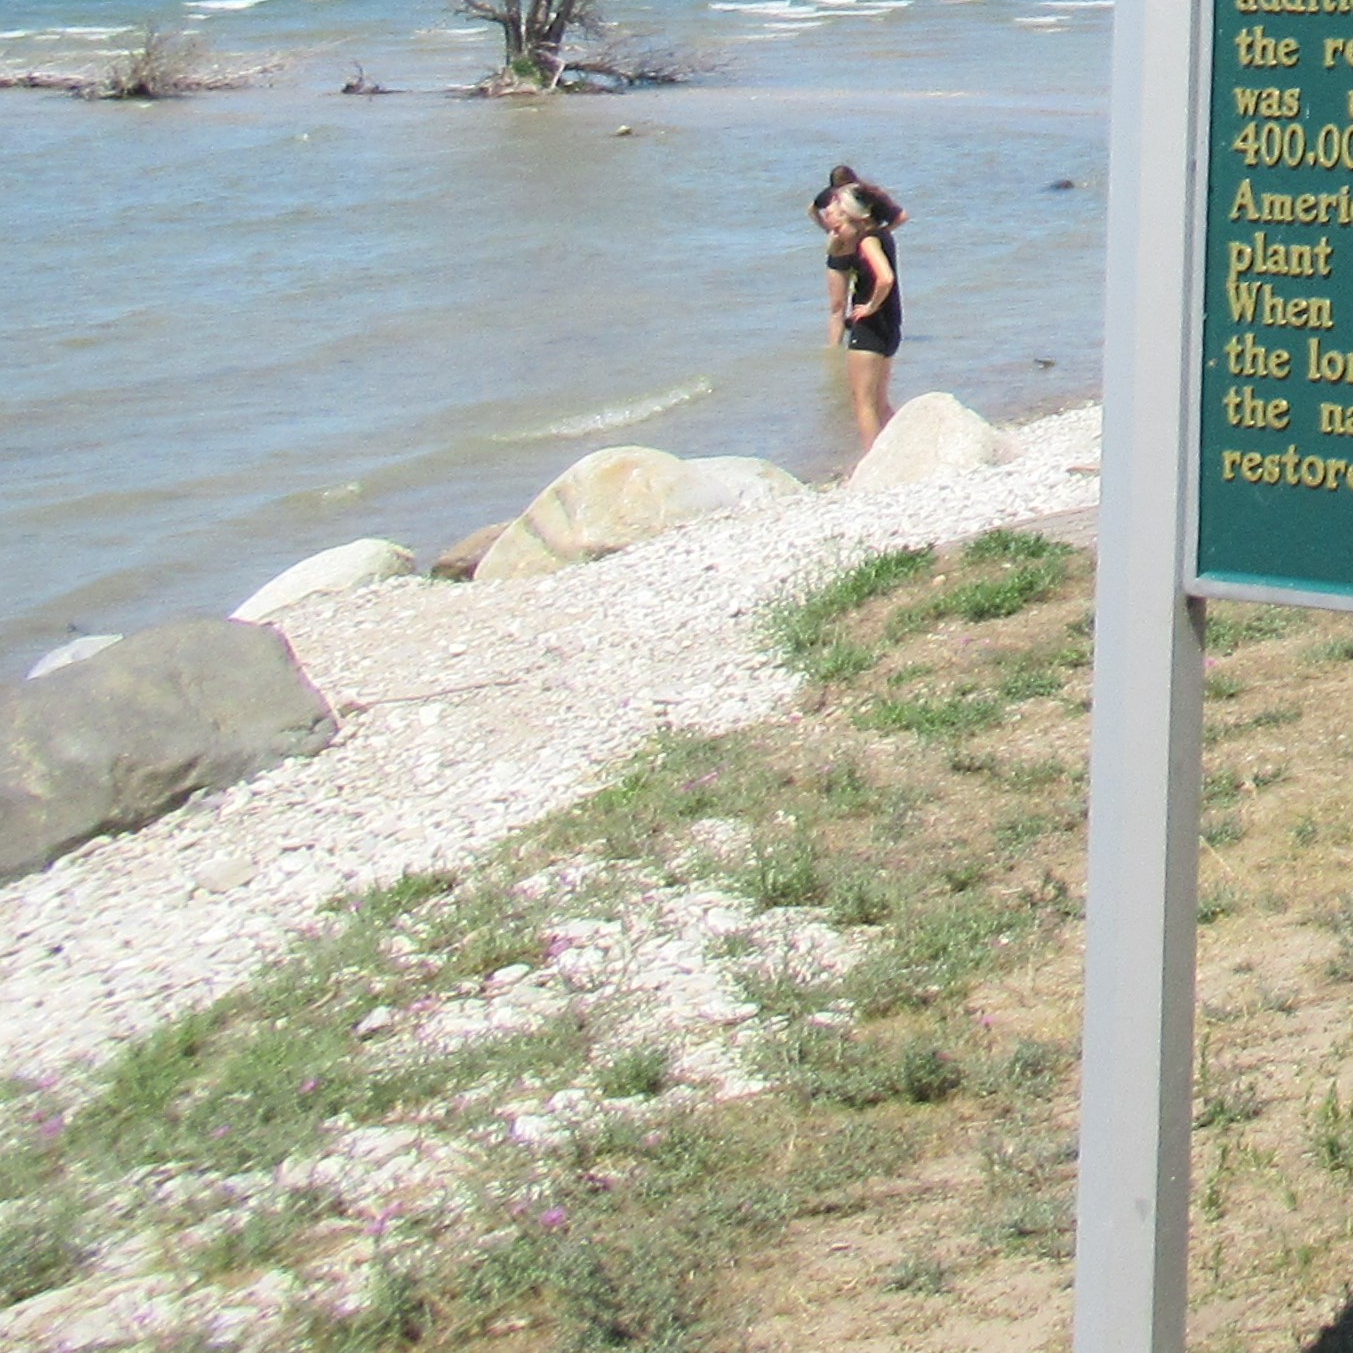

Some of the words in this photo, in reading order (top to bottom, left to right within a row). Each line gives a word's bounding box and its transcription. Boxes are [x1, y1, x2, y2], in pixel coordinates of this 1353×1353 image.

[1236, 27, 1297, 66] the
[1235, 88, 1300, 117] was
[1227, 234, 1332, 282] plant
[1228, 283, 1333, 329] When
[1226, 334, 1290, 377] the
[1226, 387, 1288, 429] the
